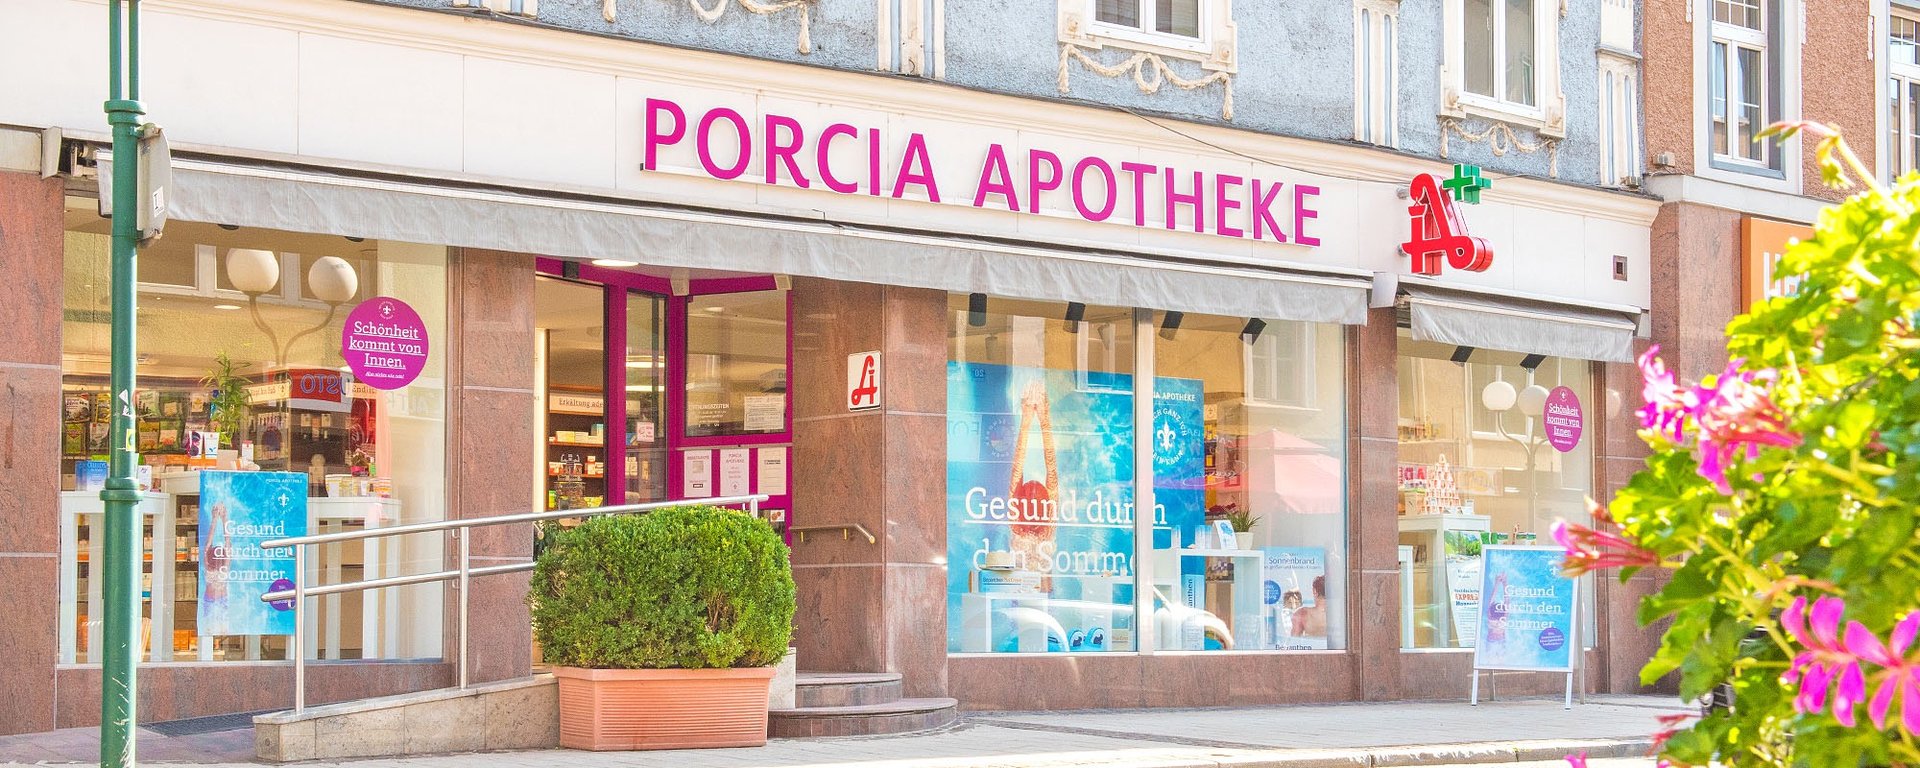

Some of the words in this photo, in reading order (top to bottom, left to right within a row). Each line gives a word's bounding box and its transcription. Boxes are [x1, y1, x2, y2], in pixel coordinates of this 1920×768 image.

[644, 97, 941, 204] PORCIA
[973, 143, 1322, 248] APOTHEKE
[354, 321, 419, 339] Schönheit
[349, 336, 395, 352] kommt
[398, 344, 423, 354] von
[364, 353, 406, 369] Innen.
[1162, 392, 1196, 402] APOTHEKE
[1548, 403, 1579, 417] Schönheit
[1162, 408, 1182, 422] GANZ
[1180, 421, 1188, 436] ICH
[1547, 413, 1568, 427] kommt
[964, 486, 1078, 523] Gesund
[1086, 490, 1168, 525] durh
[225, 520, 285, 536] Gesund
[213, 543, 260, 558] durch
[973, 538, 1027, 571] dn
[1268, 557, 1315, 565] Sonnenbrand
[217, 565, 289, 581] Sommer.
[1504, 585, 1556, 597] Gesund
[1495, 602, 1534, 614] durch
[1536, 604, 1562, 614] den
